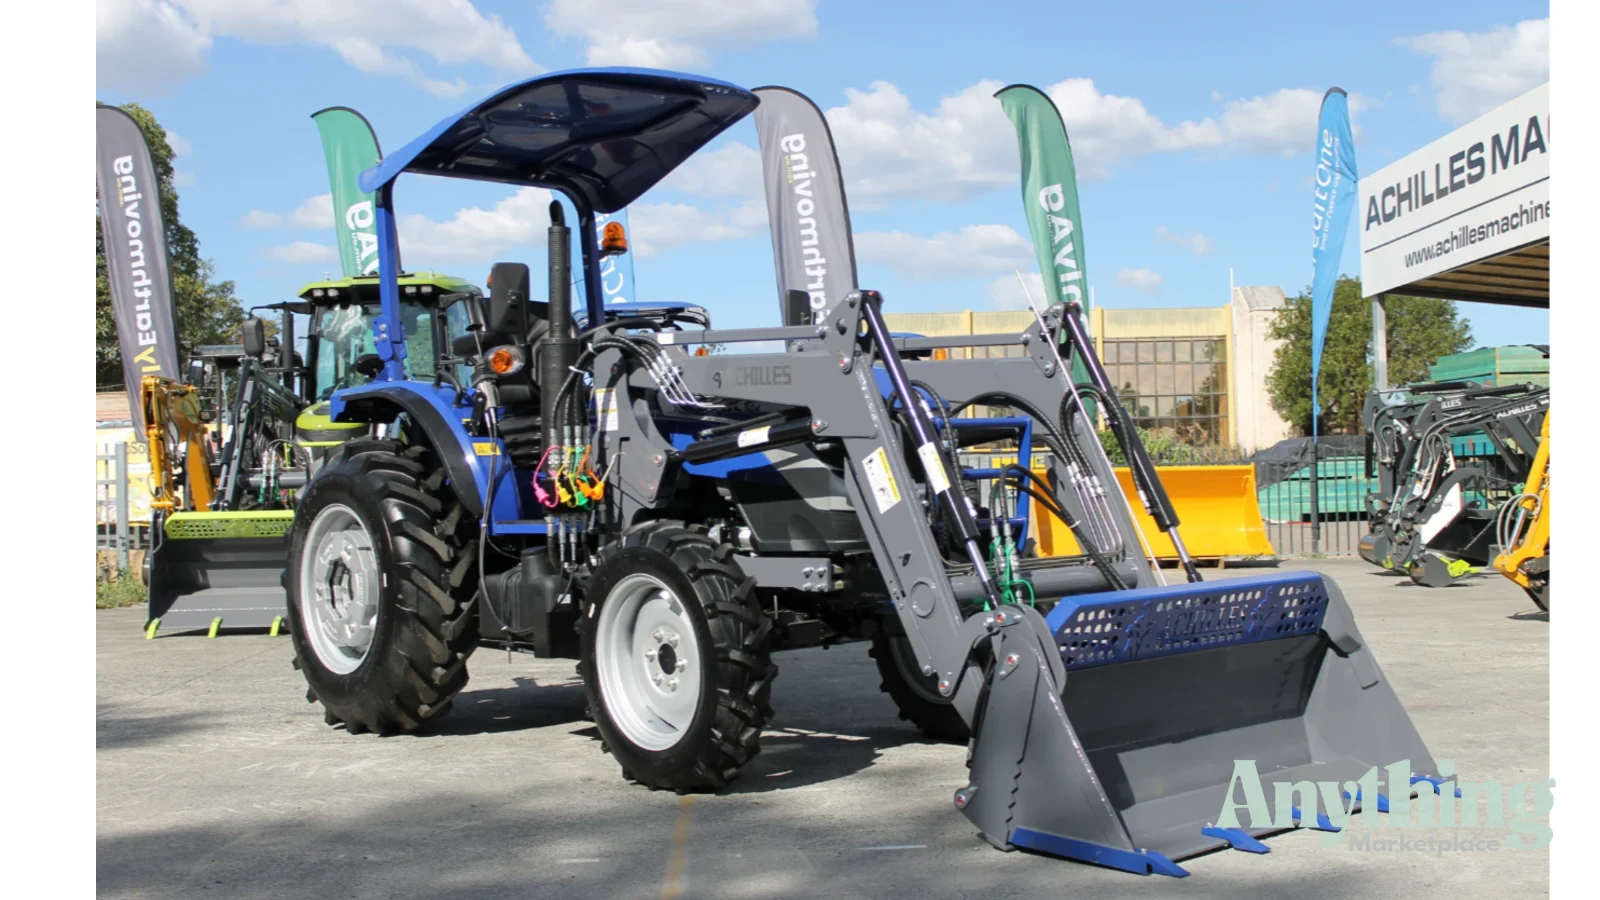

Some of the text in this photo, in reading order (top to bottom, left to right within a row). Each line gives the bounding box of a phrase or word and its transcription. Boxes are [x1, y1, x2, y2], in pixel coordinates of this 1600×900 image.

[1365, 114, 1549, 231] ACHILLES MA
[734, 365, 792, 386] CHILLES
